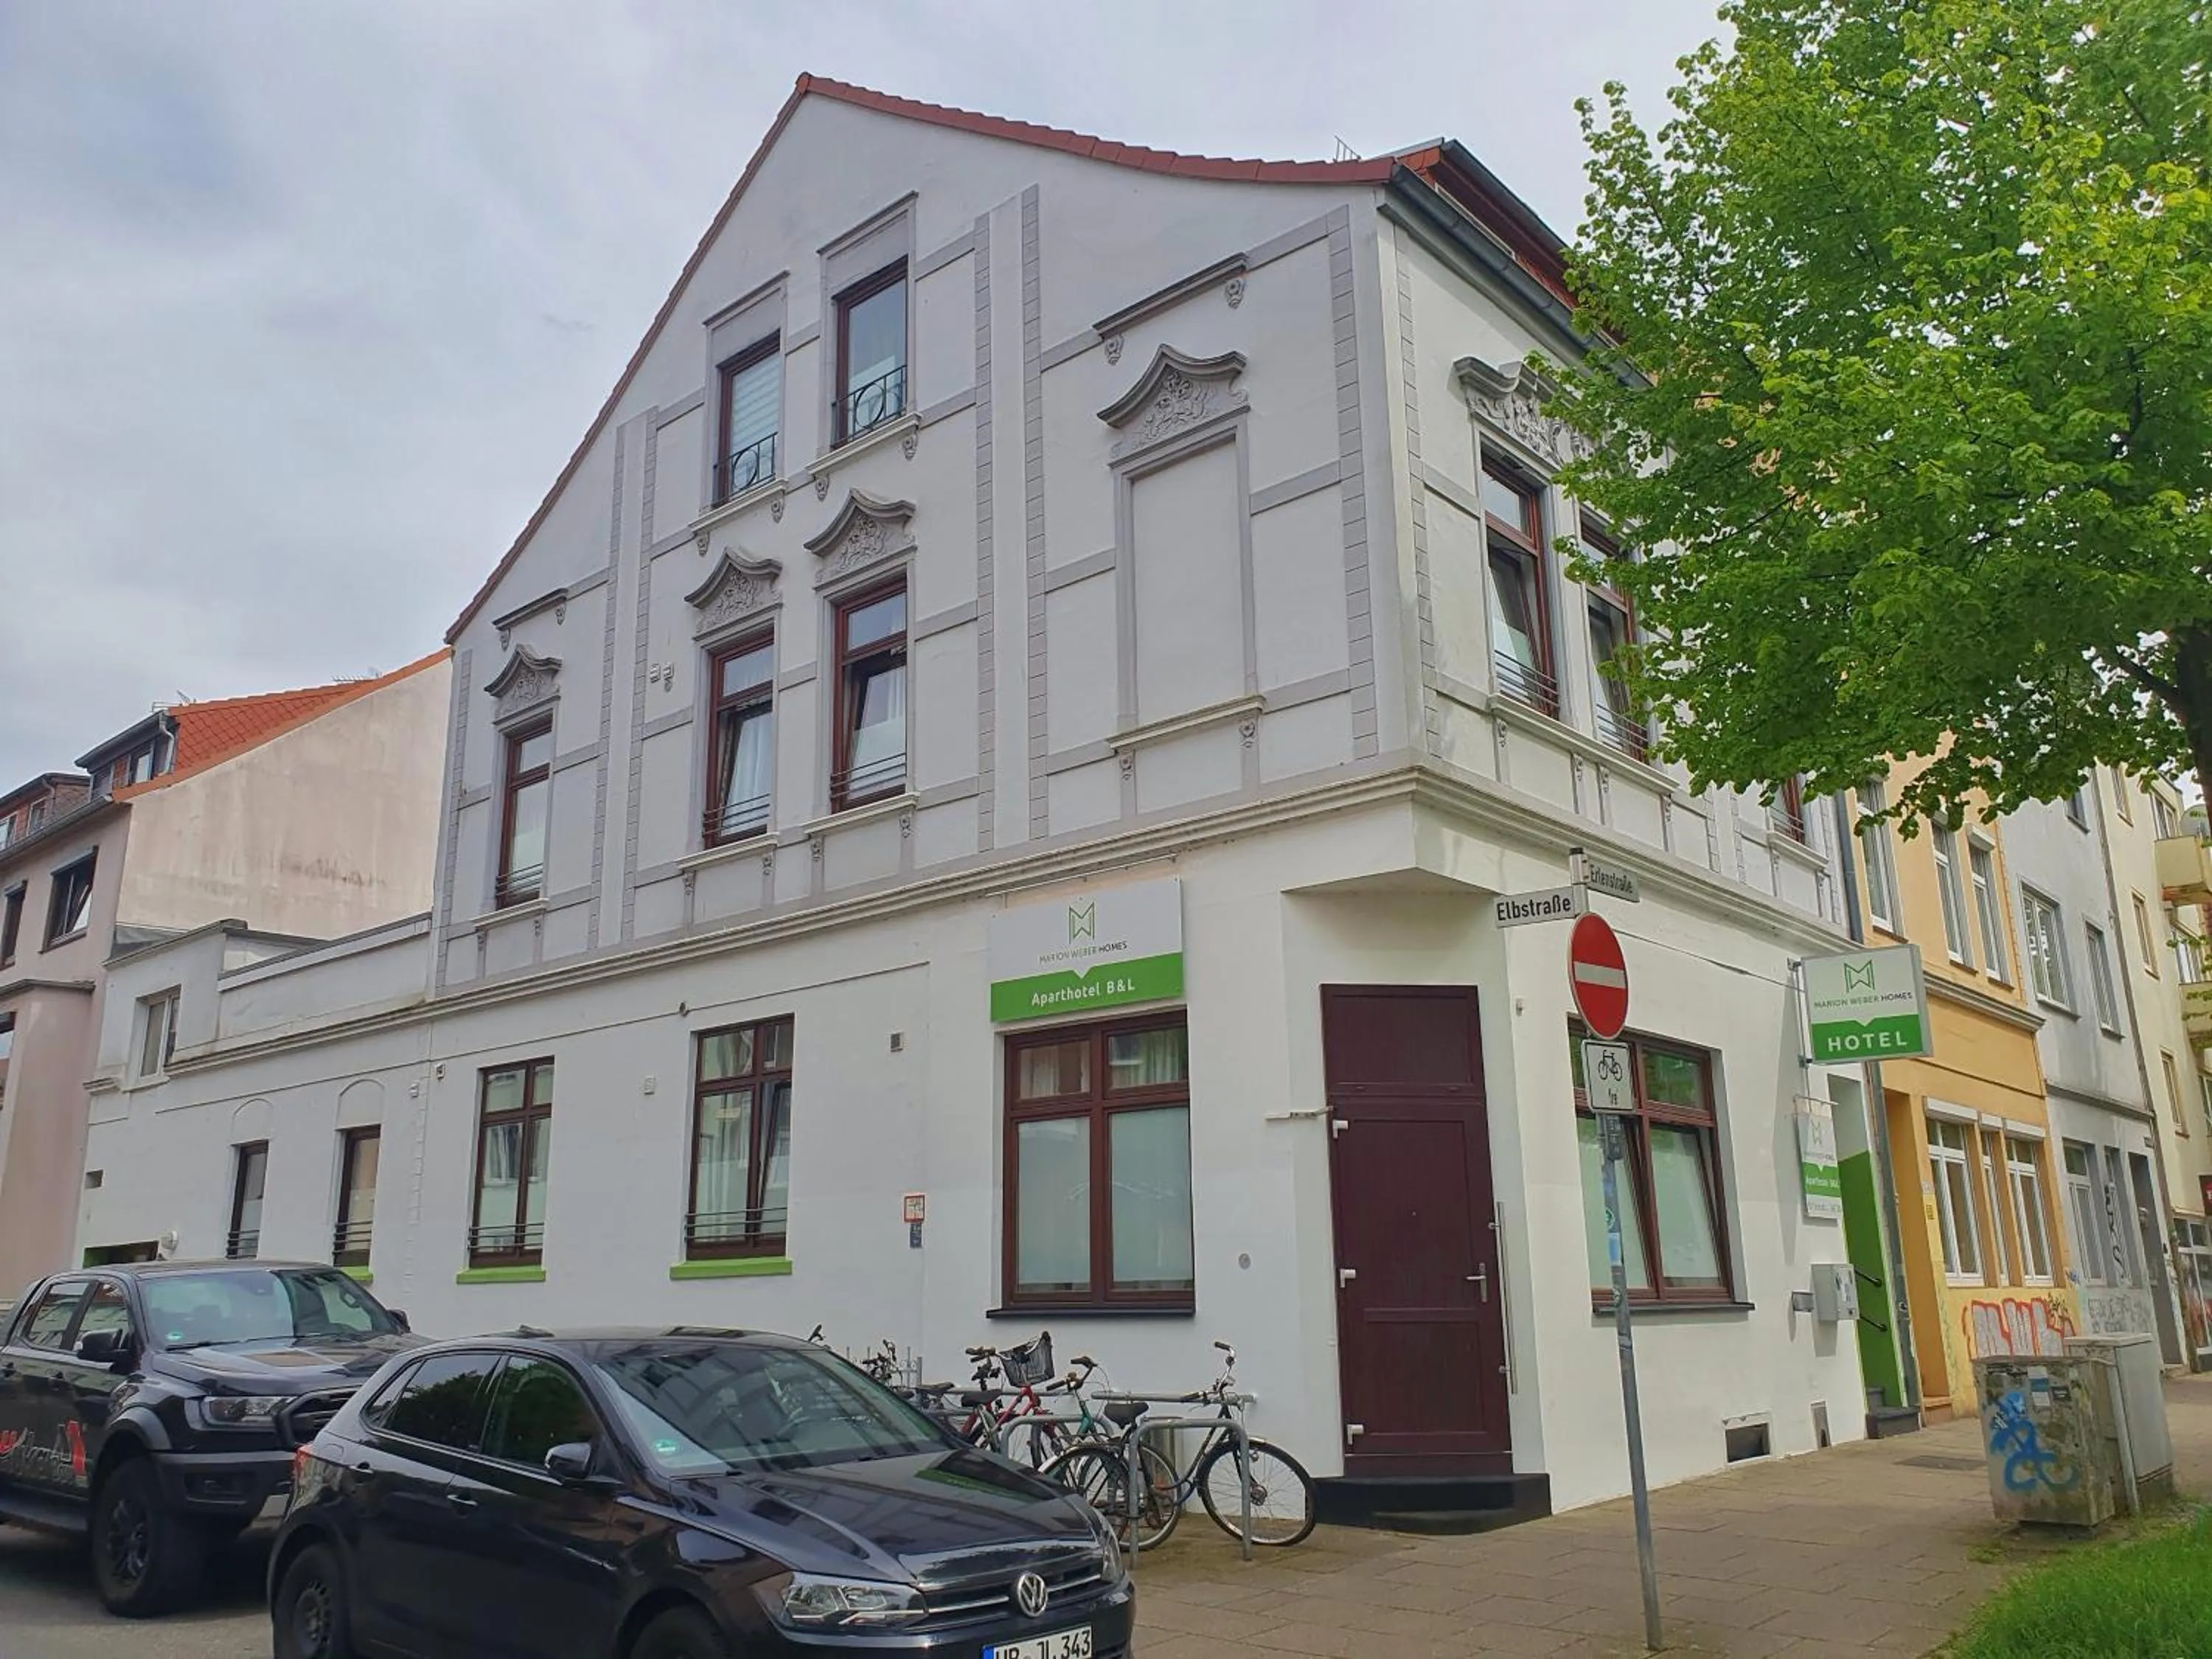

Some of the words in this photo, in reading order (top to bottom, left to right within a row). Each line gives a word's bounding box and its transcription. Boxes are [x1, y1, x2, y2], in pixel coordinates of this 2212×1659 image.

[1496, 894, 1571, 921] Elbstraße
[1099, 940, 1128, 953] HOMES
[1032, 981, 1099, 1007] Aparthotel
[1107, 978, 1135, 995] B&L
[1814, 998, 1848, 1009] MARION
[1849, 995, 1879, 1005] WEBER
[1881, 992, 1913, 1002] HOMES
[1828, 1030, 1907, 1052] HOTEL
[1061, 1629, 1091, 1659] 343
